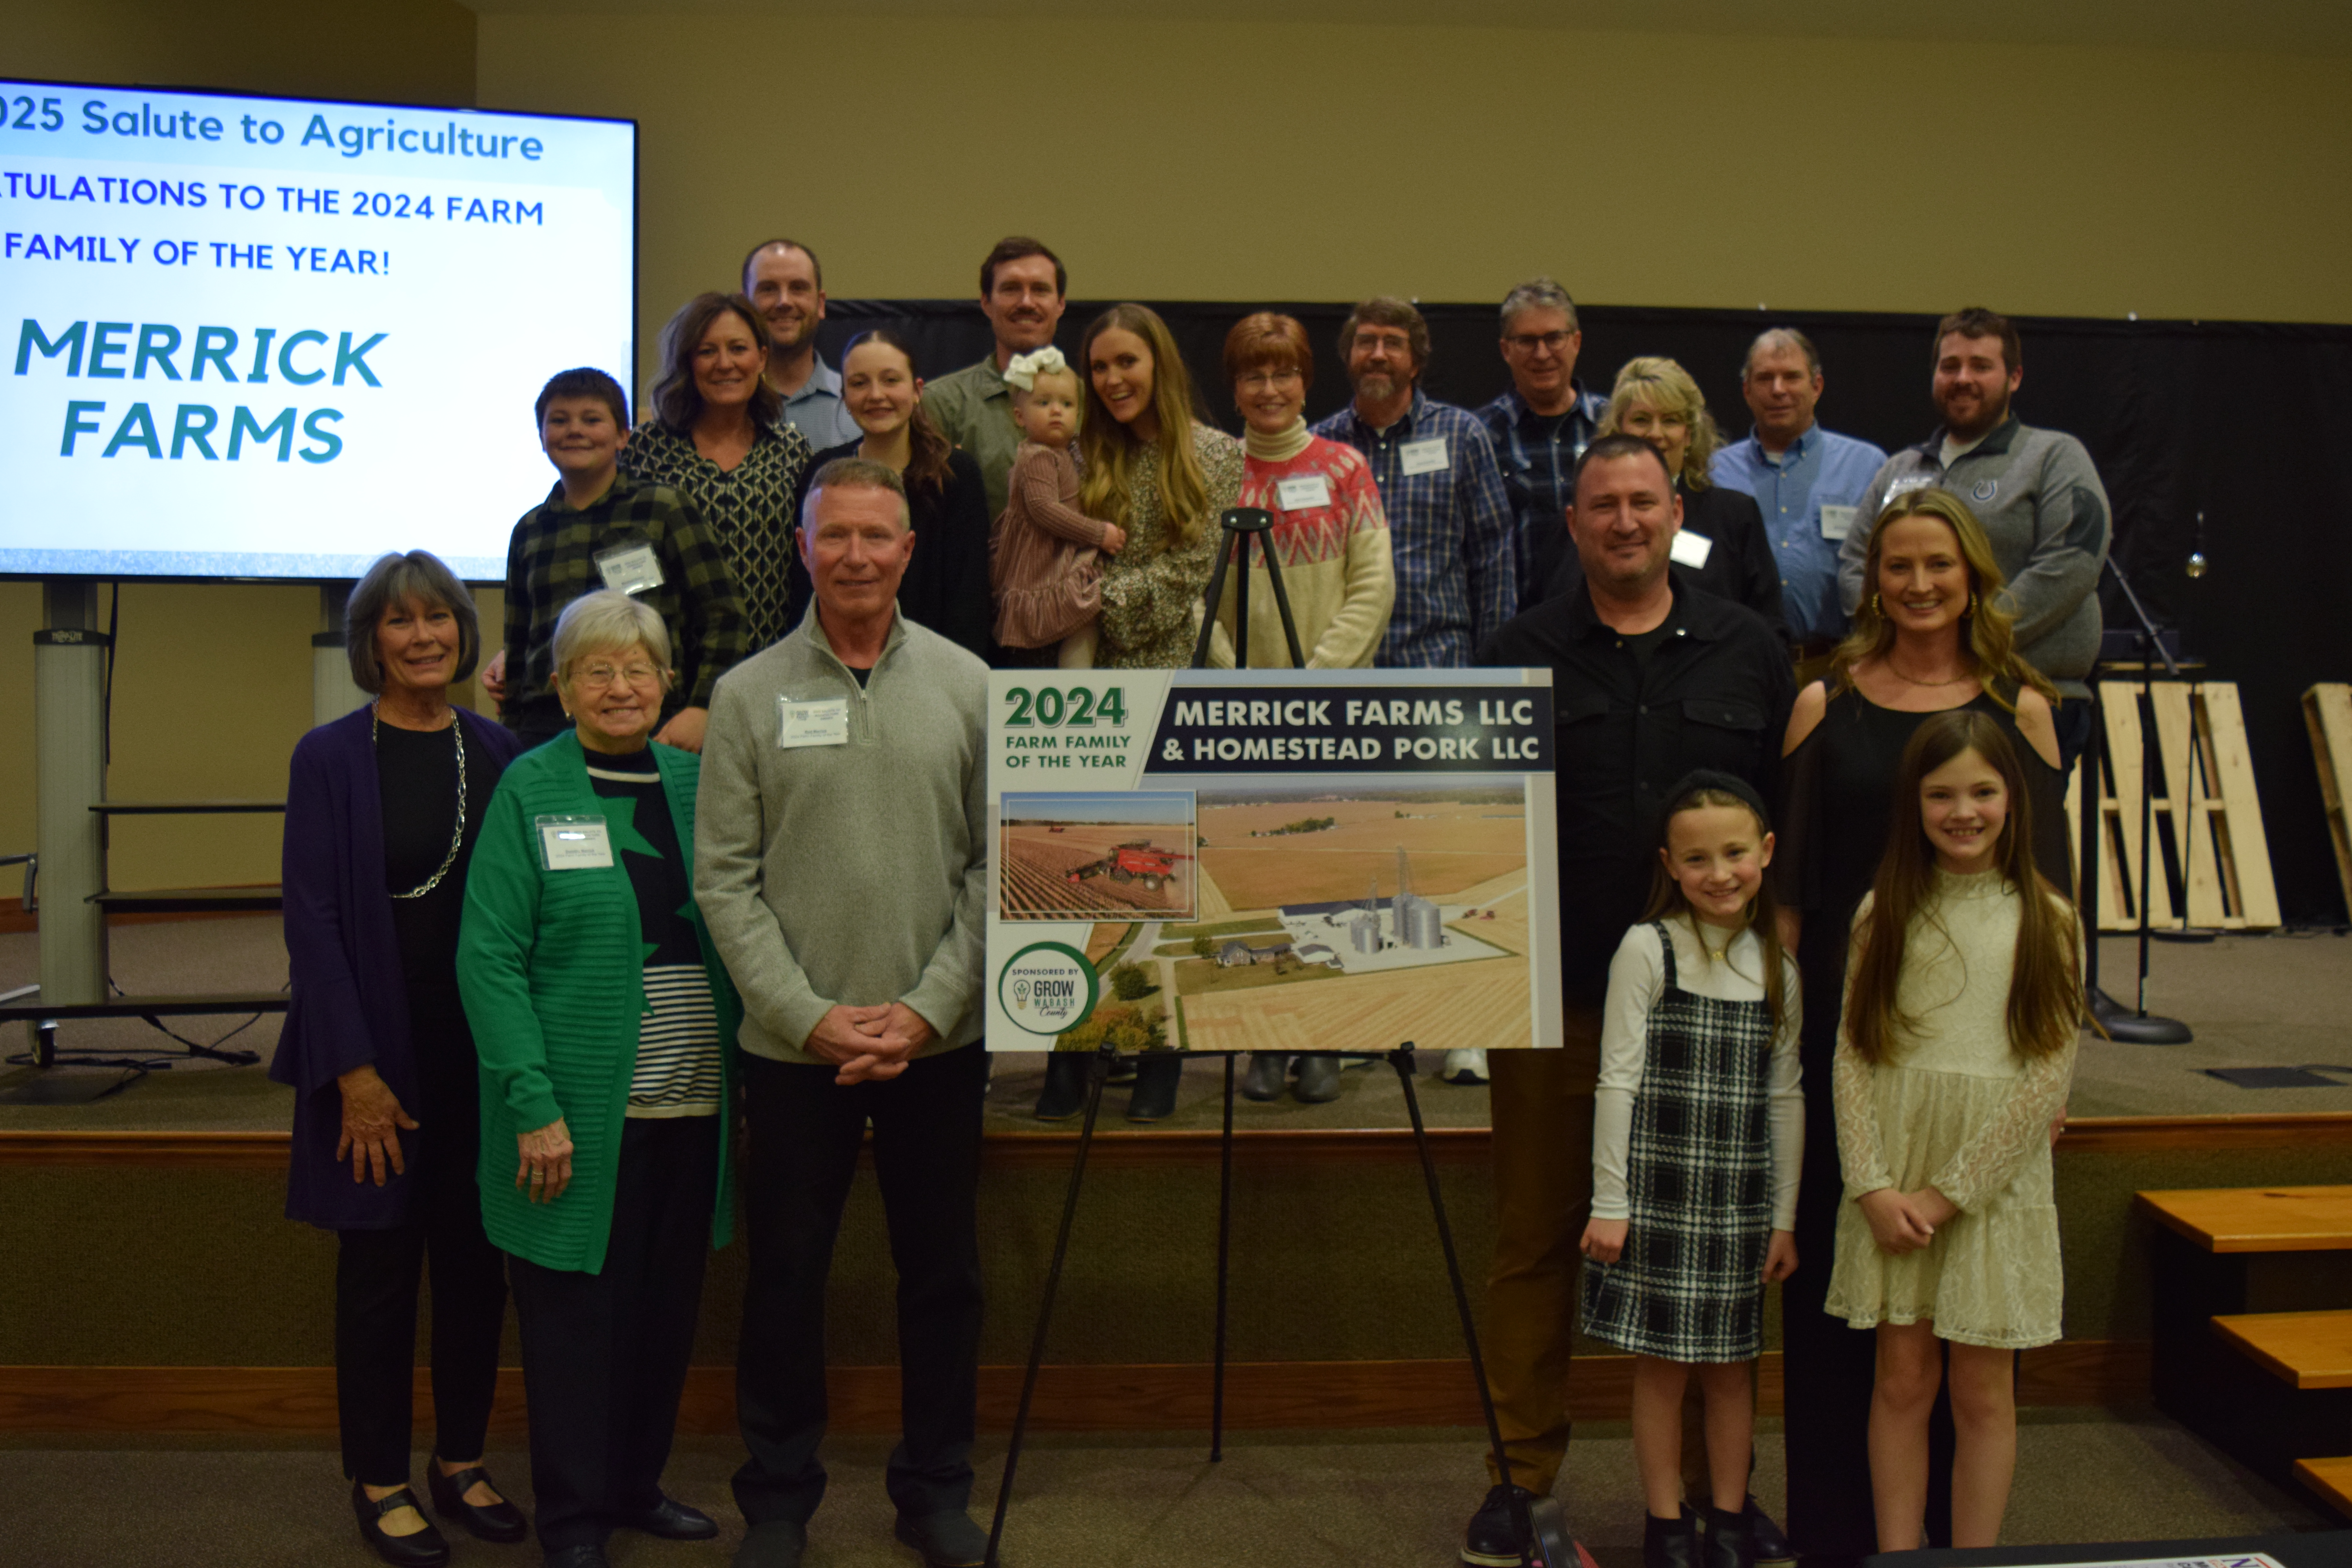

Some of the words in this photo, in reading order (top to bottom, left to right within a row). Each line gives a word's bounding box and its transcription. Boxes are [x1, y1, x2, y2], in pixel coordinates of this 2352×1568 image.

[82, 101, 223, 142] Salute
[241, 114, 285, 144] to
[300, 114, 543, 161] Agriculture
[0, 172, 207, 207] TULATIONS
[219, 184, 265, 210] TO
[277, 187, 339, 214] THE
[352, 192, 435, 220] 2024
[447, 196, 543, 226] FARM
[5, 232, 141, 263] FAMILY
[153, 240, 198, 266] OF
[209, 242, 273, 270] THE
[286, 247, 389, 276] YEAR!
[14, 319, 390, 388] MERRICK
[60, 400, 345, 465] FARMS
[1004, 687, 1128, 728] 2024
[1174, 701, 1332, 726] MERRICK
[1346, 700, 1464, 725] FARMS
[1479, 699, 1533, 725] LLC
[1006, 736, 1058, 749] FARM
[1065, 736, 1131, 748] FAMILY
[1162, 738, 1185, 761] &
[1194, 737, 1381, 761] HOMESTEAD
[1394, 737, 1480, 760] PORK
[1492, 737, 1539, 760] LLC
[1006, 755, 1030, 768] OF
[1038, 755, 1071, 768] THE
[1079, 755, 1126, 768] YEAR
[1034, 980, 1074, 997] GROW
[1034, 998, 1075, 1007] WABASH
[1040, 1005, 1067, 1019] County
